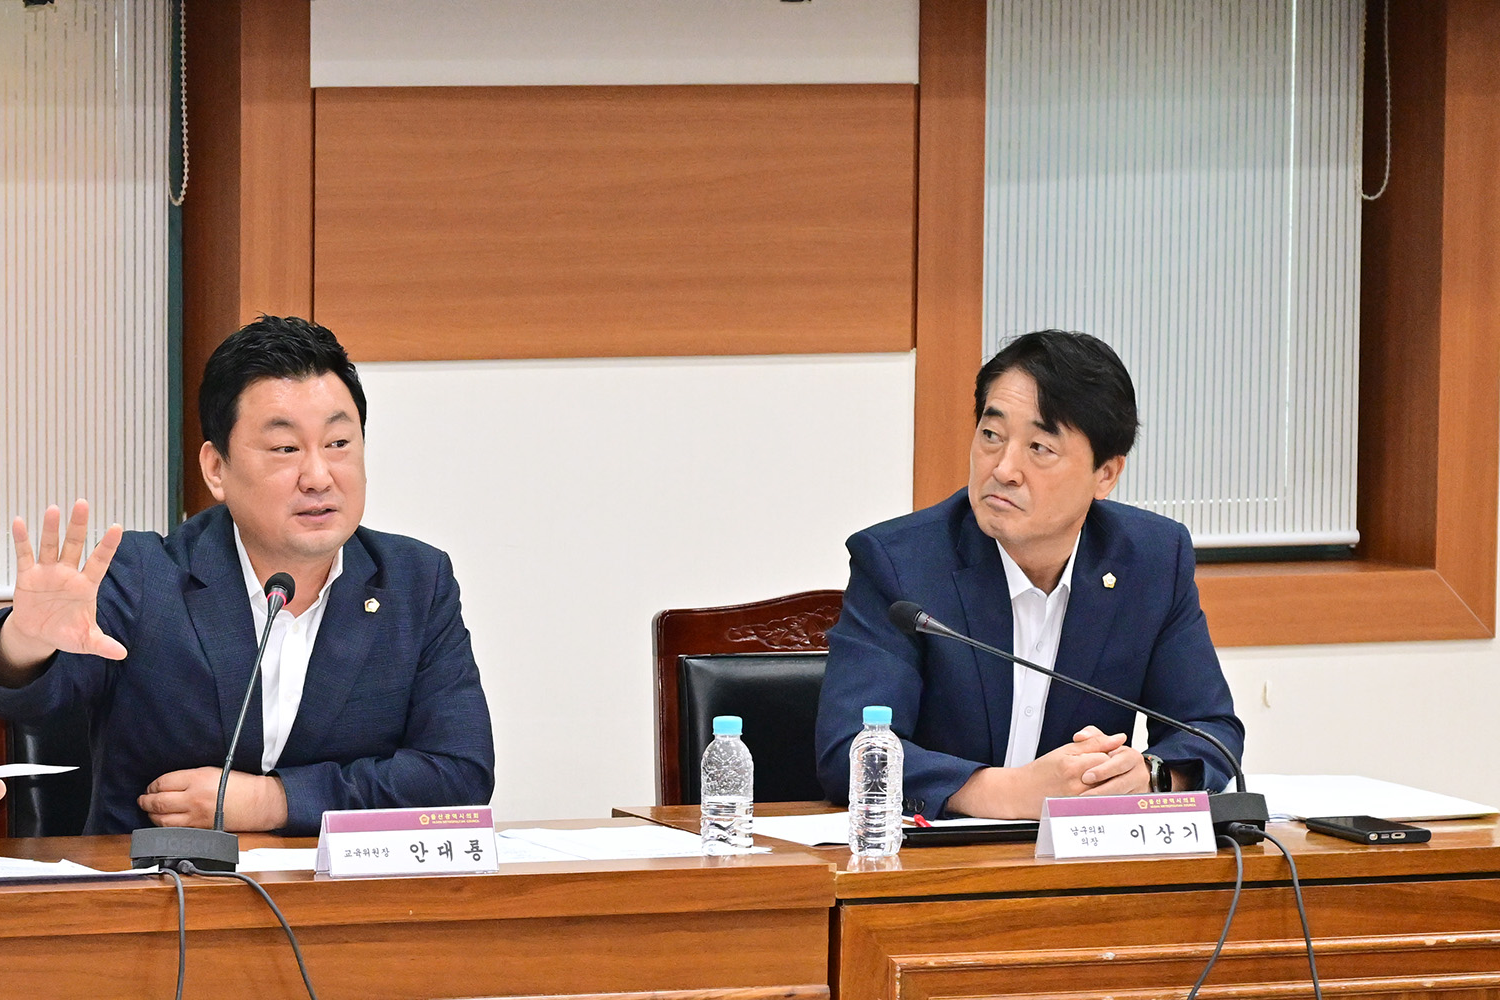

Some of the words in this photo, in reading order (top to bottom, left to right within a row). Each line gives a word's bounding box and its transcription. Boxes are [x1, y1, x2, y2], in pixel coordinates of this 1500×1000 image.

[1070, 825, 1106, 837] 남구의회
[1129, 822, 1200, 845] 이상기
[1081, 837, 1099, 847] 의장
[344, 847, 390, 859] 교육위원장
[409, 839, 483, 864] 안대룡
